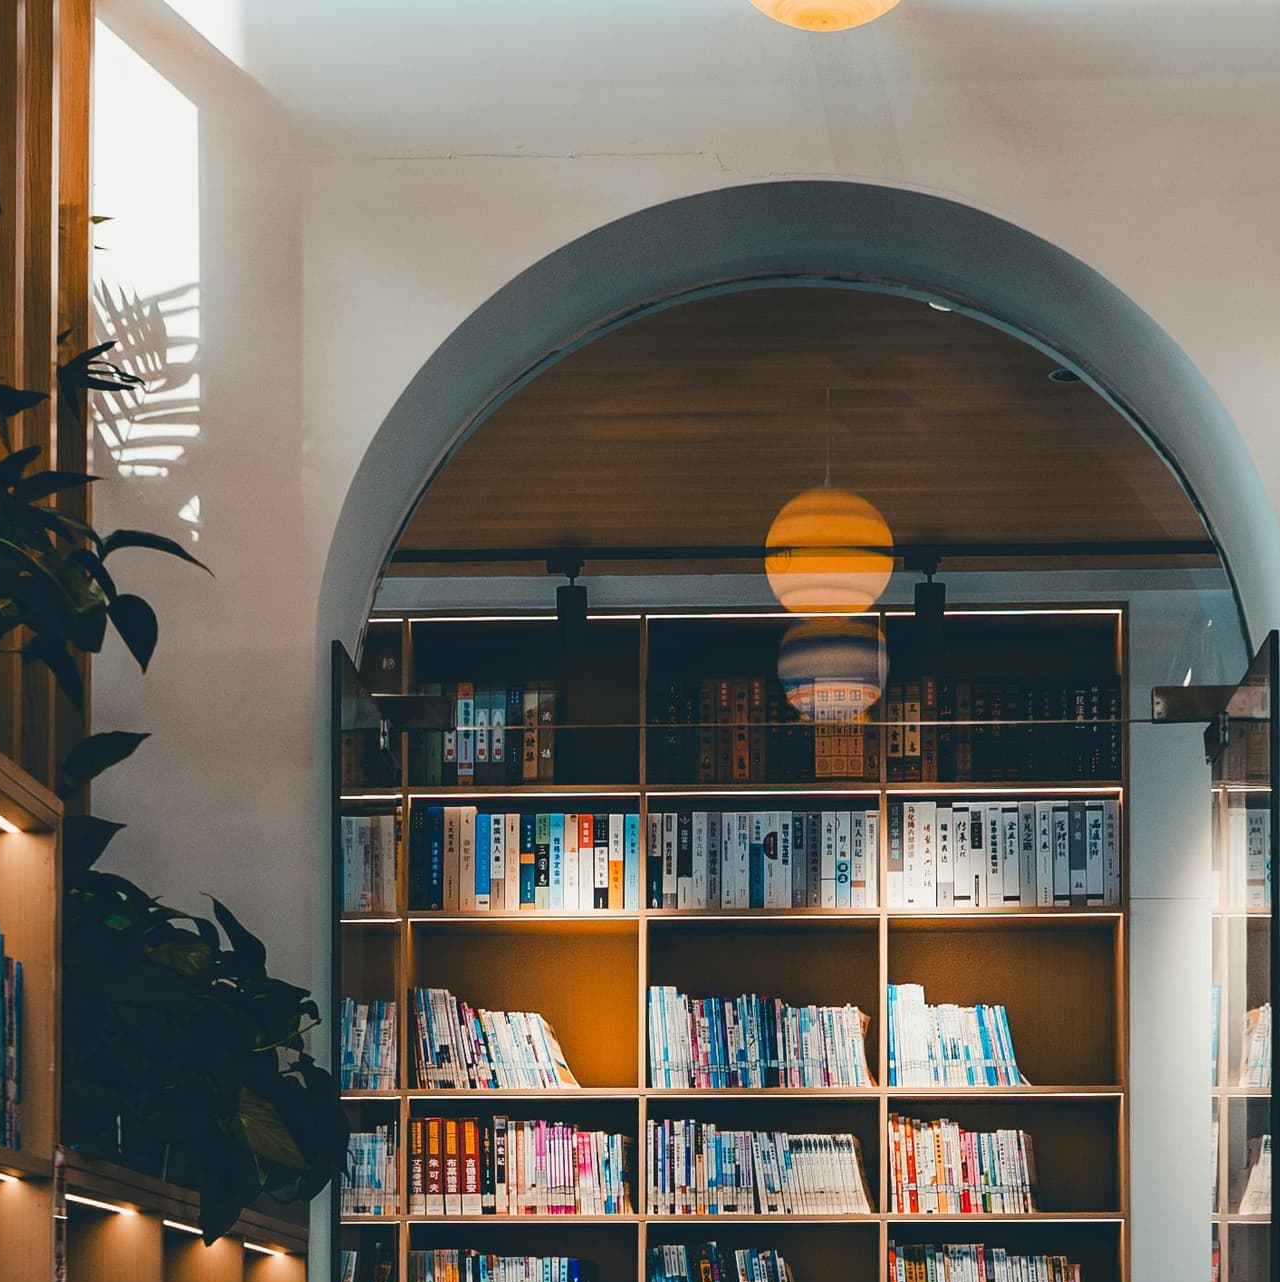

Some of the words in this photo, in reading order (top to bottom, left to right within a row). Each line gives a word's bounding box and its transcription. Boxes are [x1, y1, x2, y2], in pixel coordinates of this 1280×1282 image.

[854, 819, 863, 858] 狂人日记
[428, 1158, 440, 1193] 朱可夫
